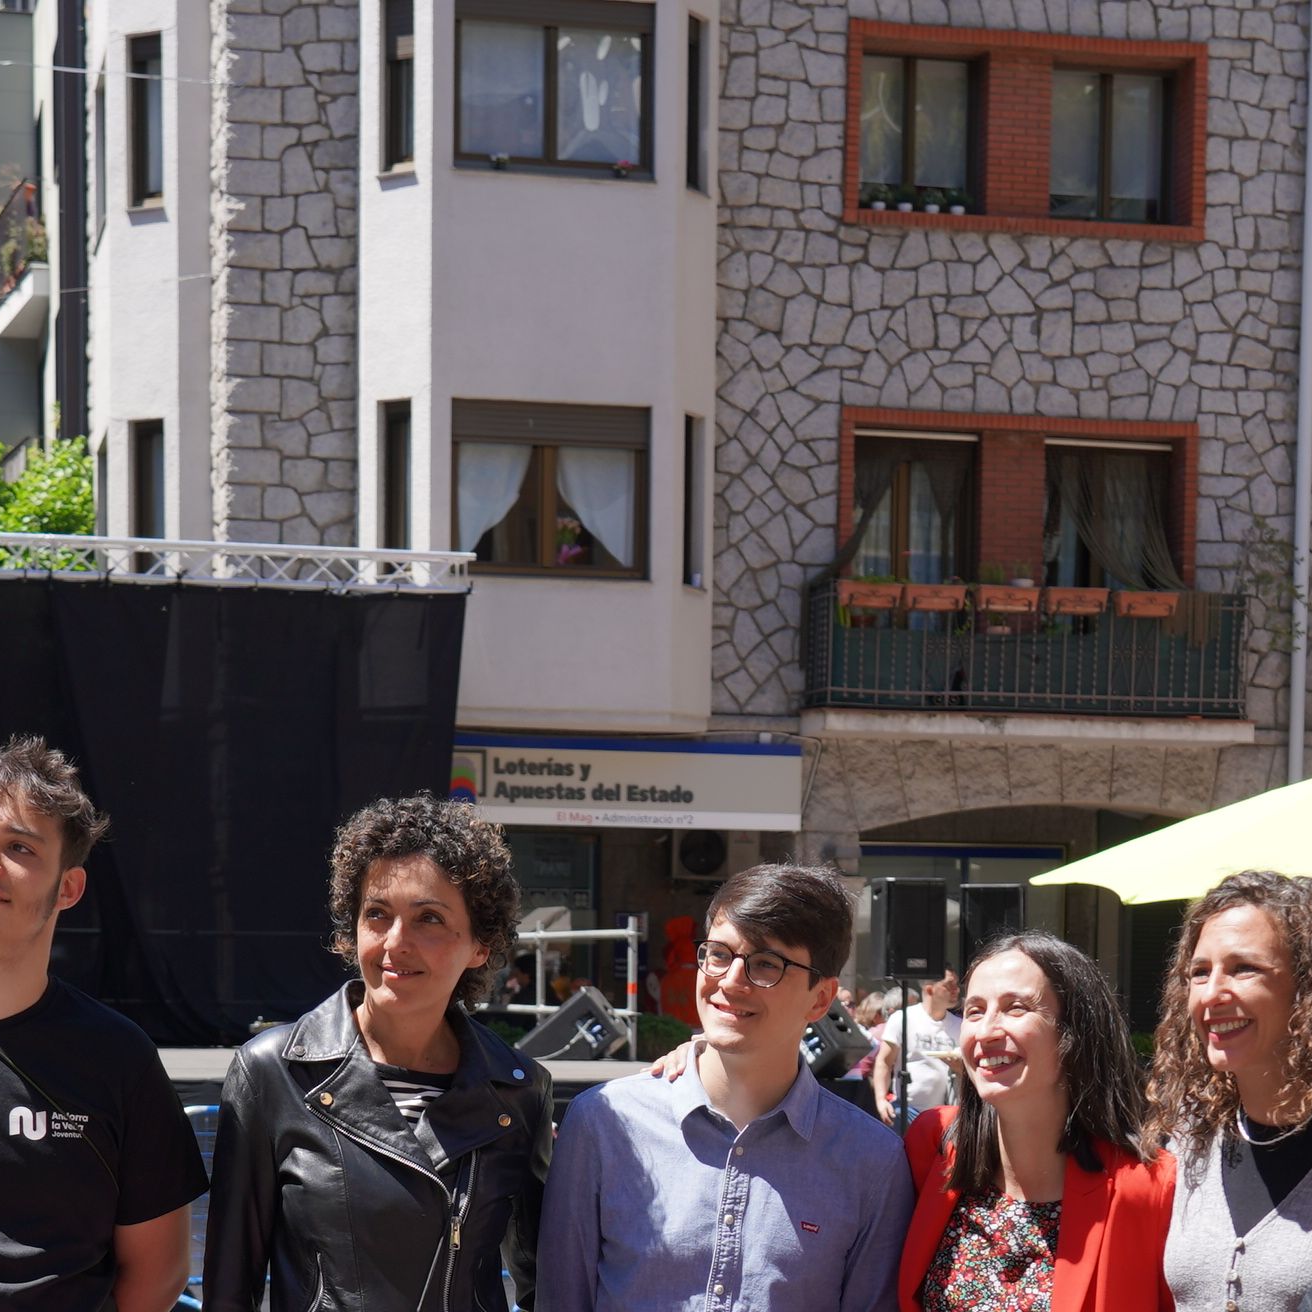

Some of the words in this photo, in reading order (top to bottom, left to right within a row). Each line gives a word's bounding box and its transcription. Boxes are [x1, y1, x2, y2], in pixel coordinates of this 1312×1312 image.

[493, 756, 575, 777] Loterías
[579, 762, 592, 781] y
[493, 780, 587, 802] Apuestas
[591, 784, 621, 801] del
[626, 785, 695, 803] Estado
[557, 811, 567, 822] El
[51, 1121, 61, 1129] la
